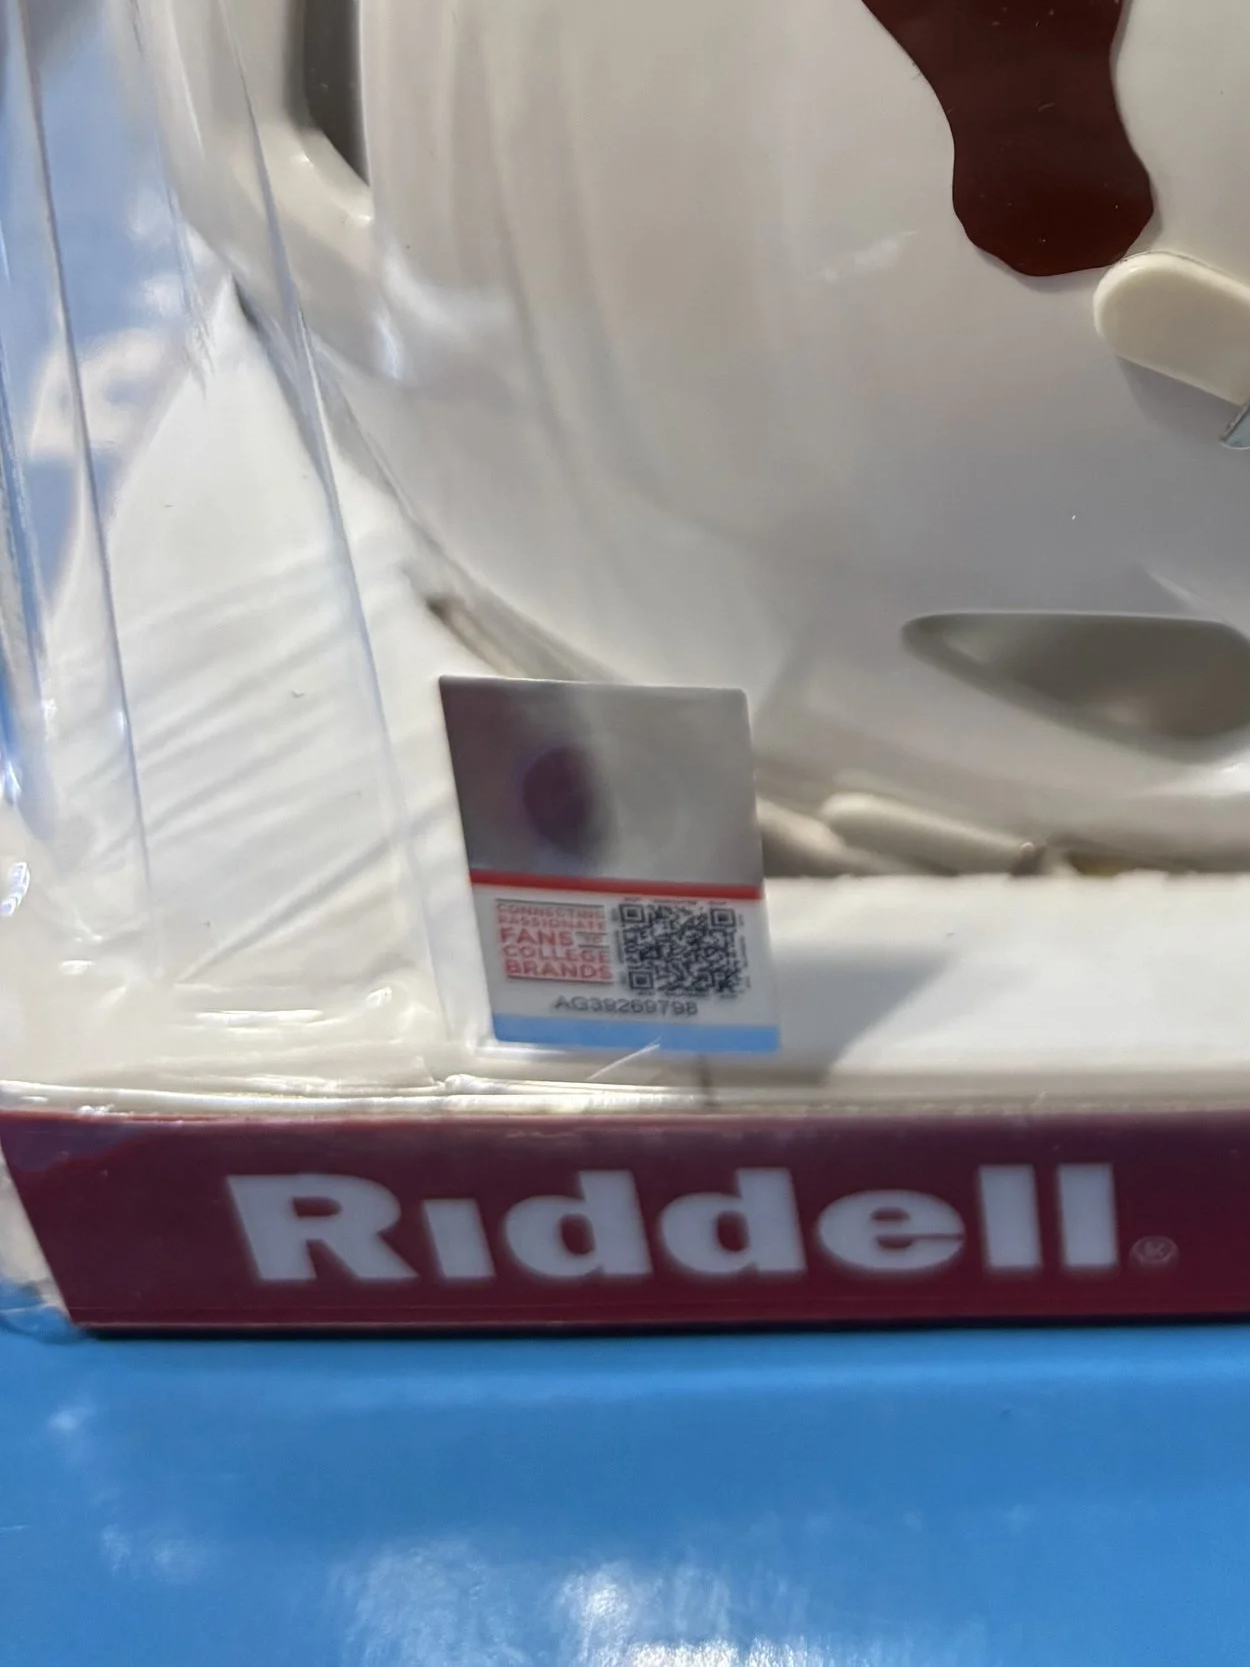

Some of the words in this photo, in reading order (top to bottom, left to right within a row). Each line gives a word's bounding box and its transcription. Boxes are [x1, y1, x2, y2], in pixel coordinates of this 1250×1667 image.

[500, 926, 574, 947] FANS
[502, 944, 613, 964] COLLEGE
[504, 958, 614, 980] BRANDS
[226, 1162, 1120, 1283] Riddell
